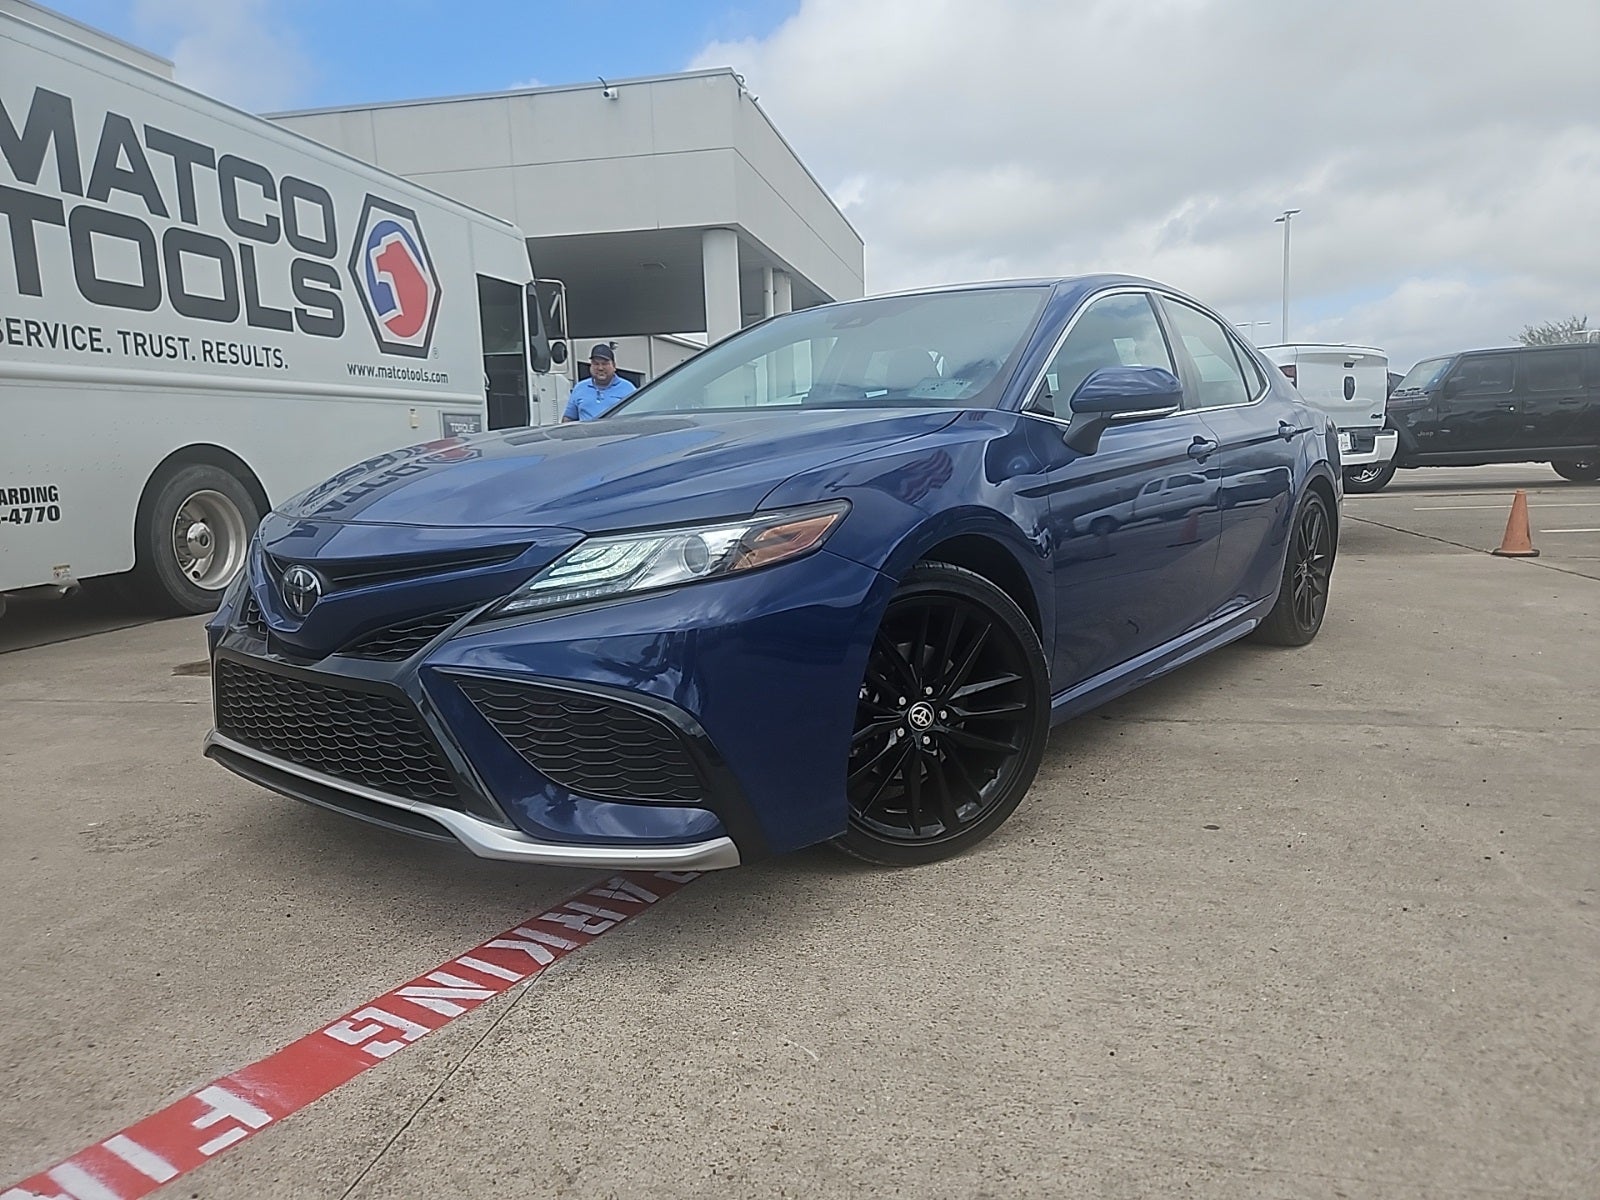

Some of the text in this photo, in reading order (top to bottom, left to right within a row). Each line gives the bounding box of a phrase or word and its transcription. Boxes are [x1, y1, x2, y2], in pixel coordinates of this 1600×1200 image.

[0, 86, 338, 260] MATCO
[0, 184, 345, 338] TOOLS
[0, 317, 289, 370] ERVICE. TRUST. RESULTS.
[347, 363, 449, 384] www.matcotools.com
[0, 505, 61, 525] -4770
